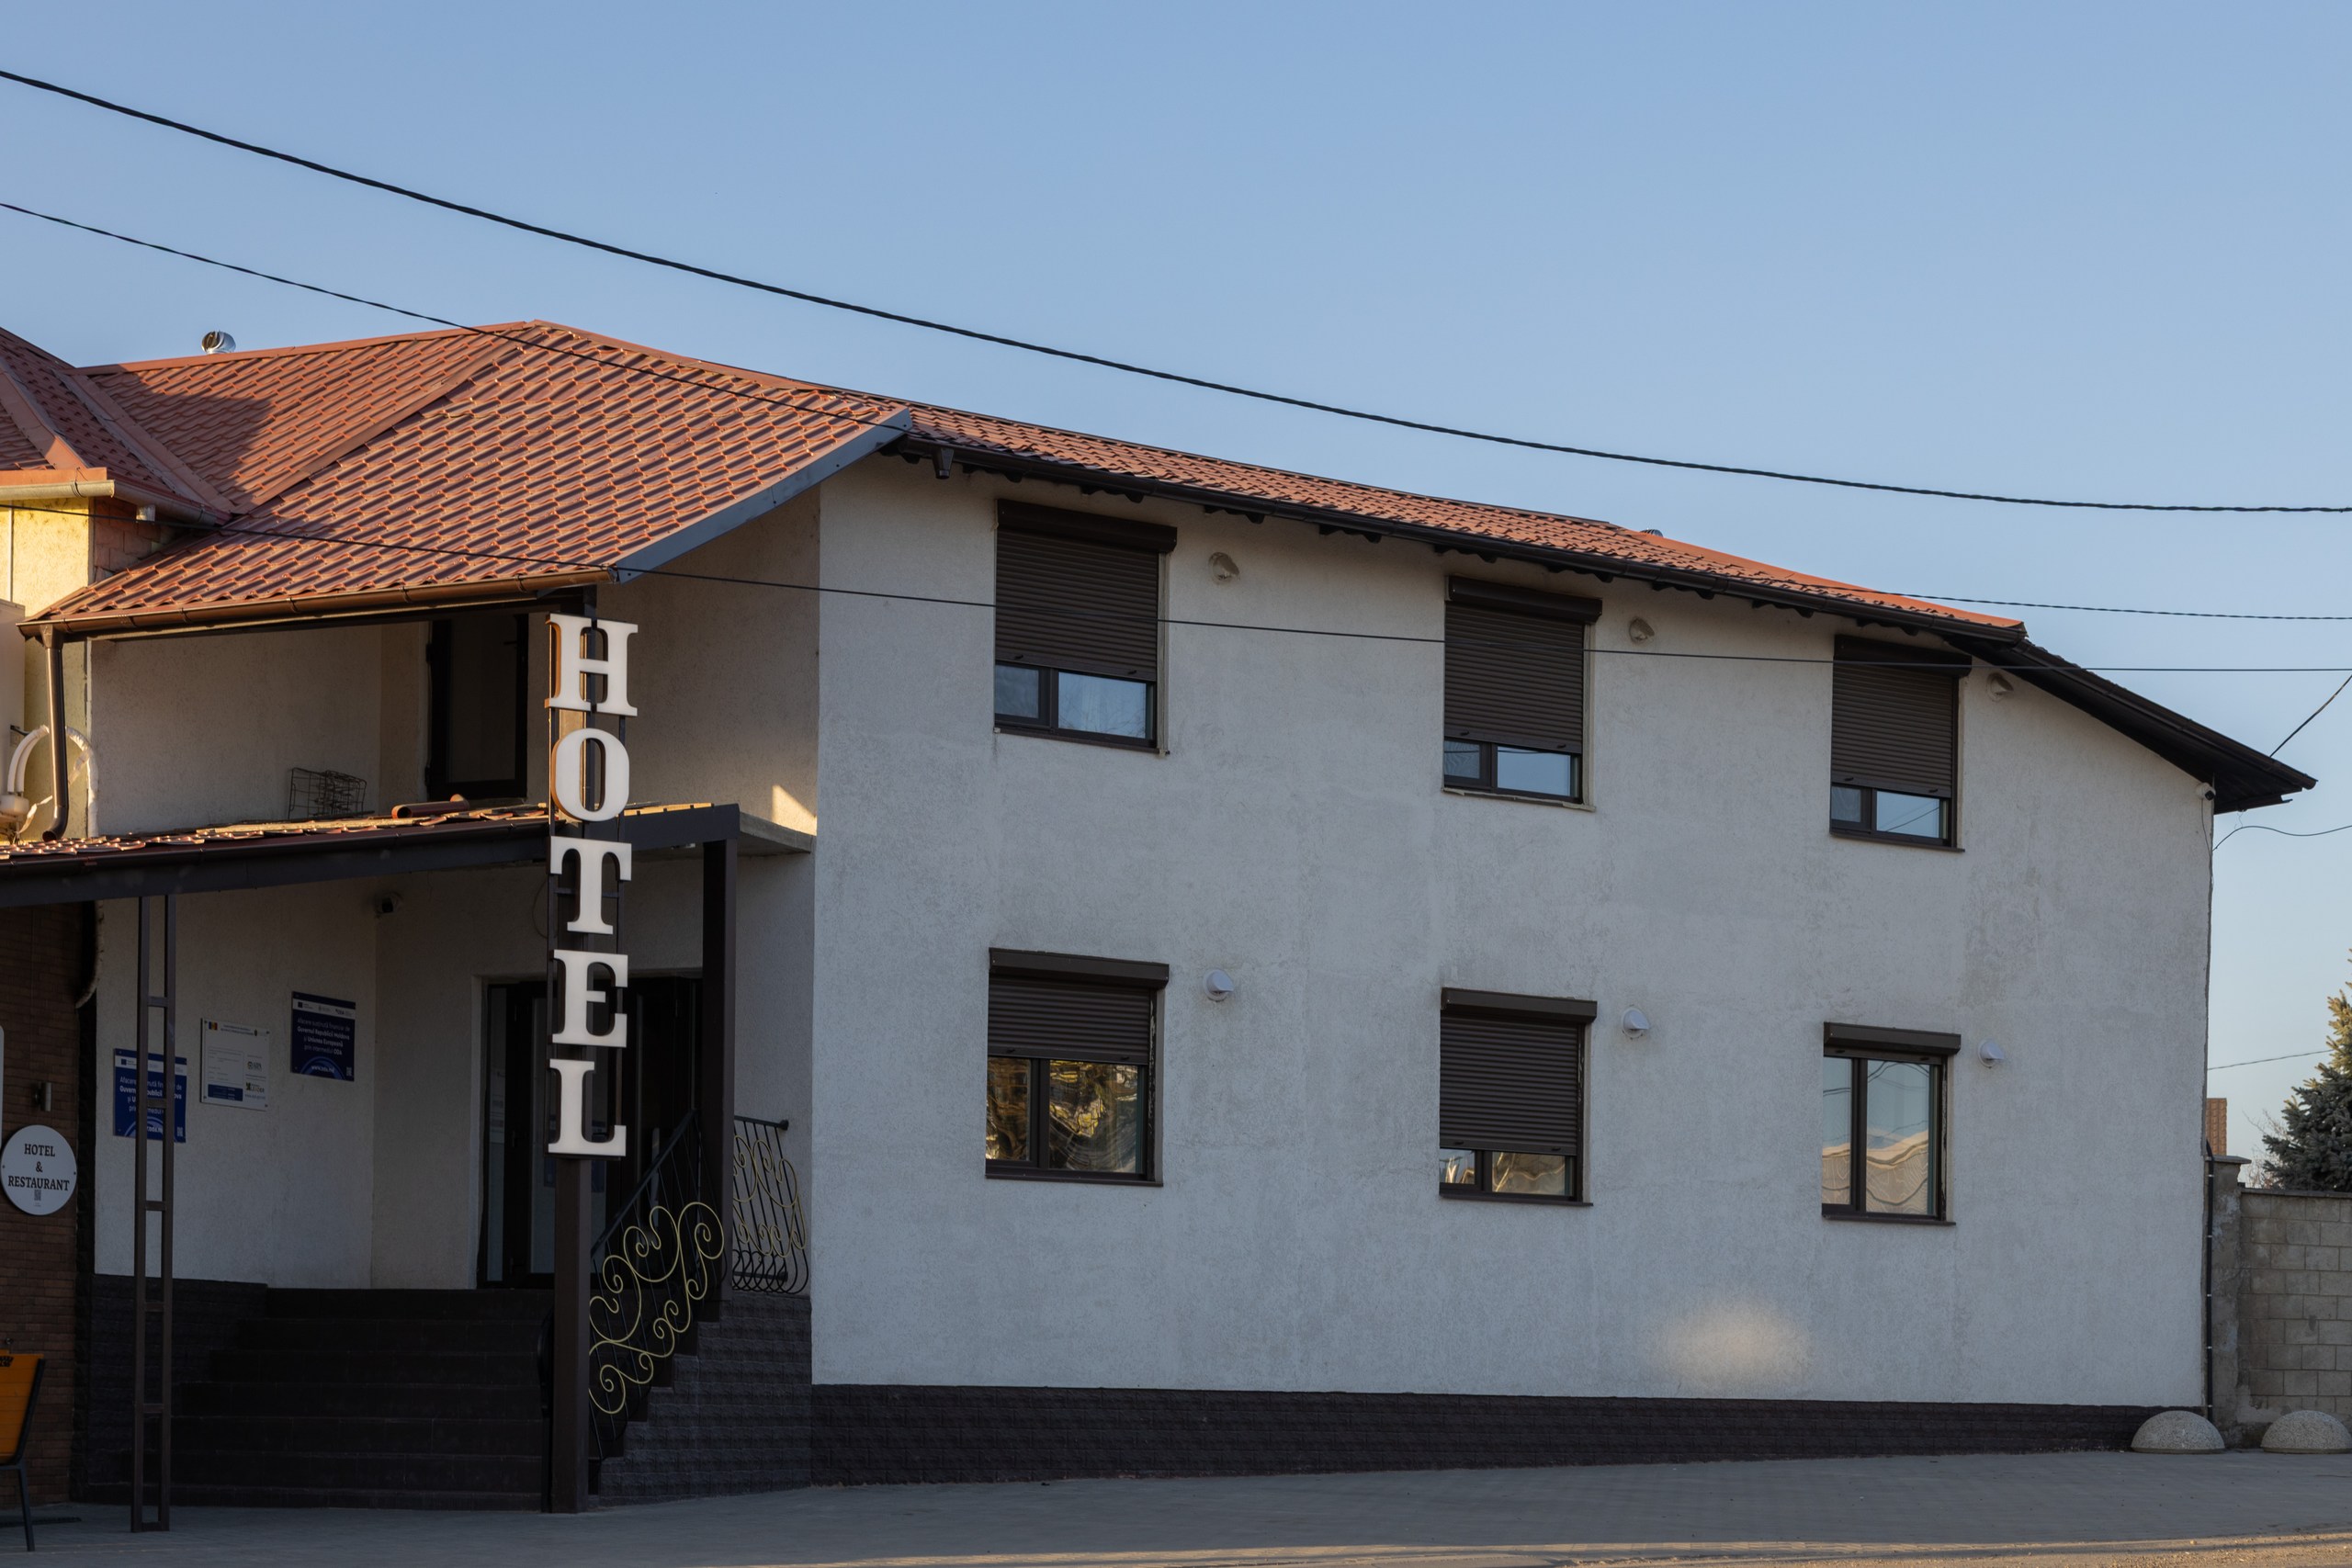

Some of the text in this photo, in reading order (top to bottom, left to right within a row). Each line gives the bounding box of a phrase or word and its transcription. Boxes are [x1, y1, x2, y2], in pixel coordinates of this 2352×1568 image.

[547, 614, 639, 1156] HOTEL
[24, 1143, 55, 1157] HOTEL
[35, 1161, 43, 1173] &
[7, 1175, 70, 1191] RESTAURANT
